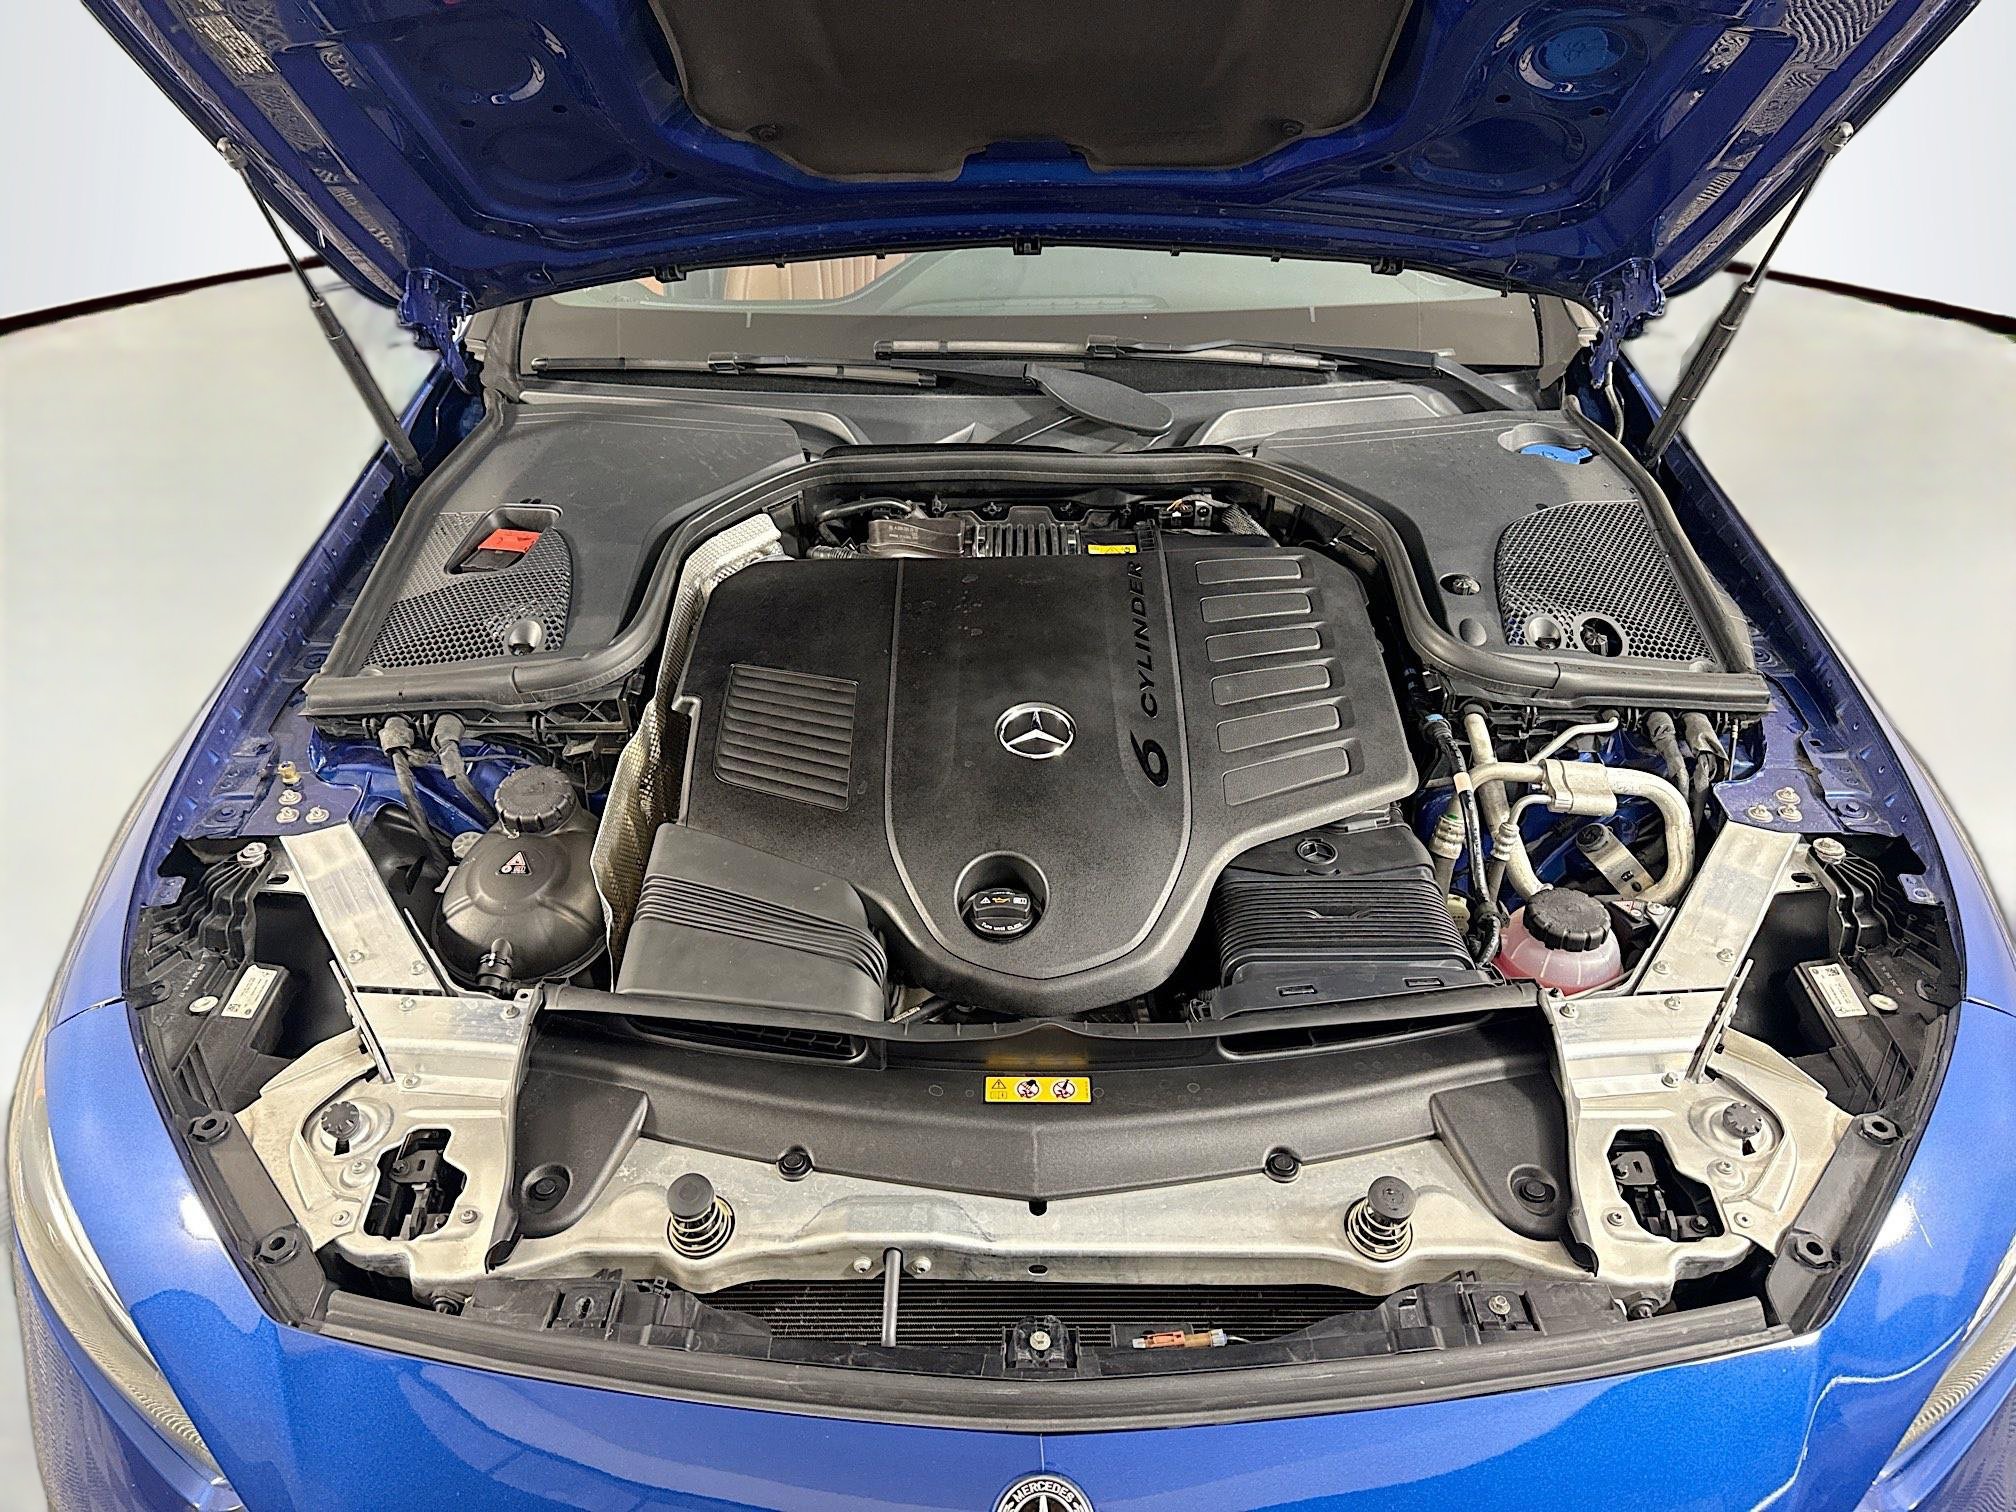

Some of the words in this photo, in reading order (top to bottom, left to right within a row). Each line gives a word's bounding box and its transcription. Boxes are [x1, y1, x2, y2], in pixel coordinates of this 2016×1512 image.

[1127, 560, 1158, 720] CYLINDER
[1129, 729, 1169, 789] 6
[1012, 1480, 1075, 1503] MERCEDES
